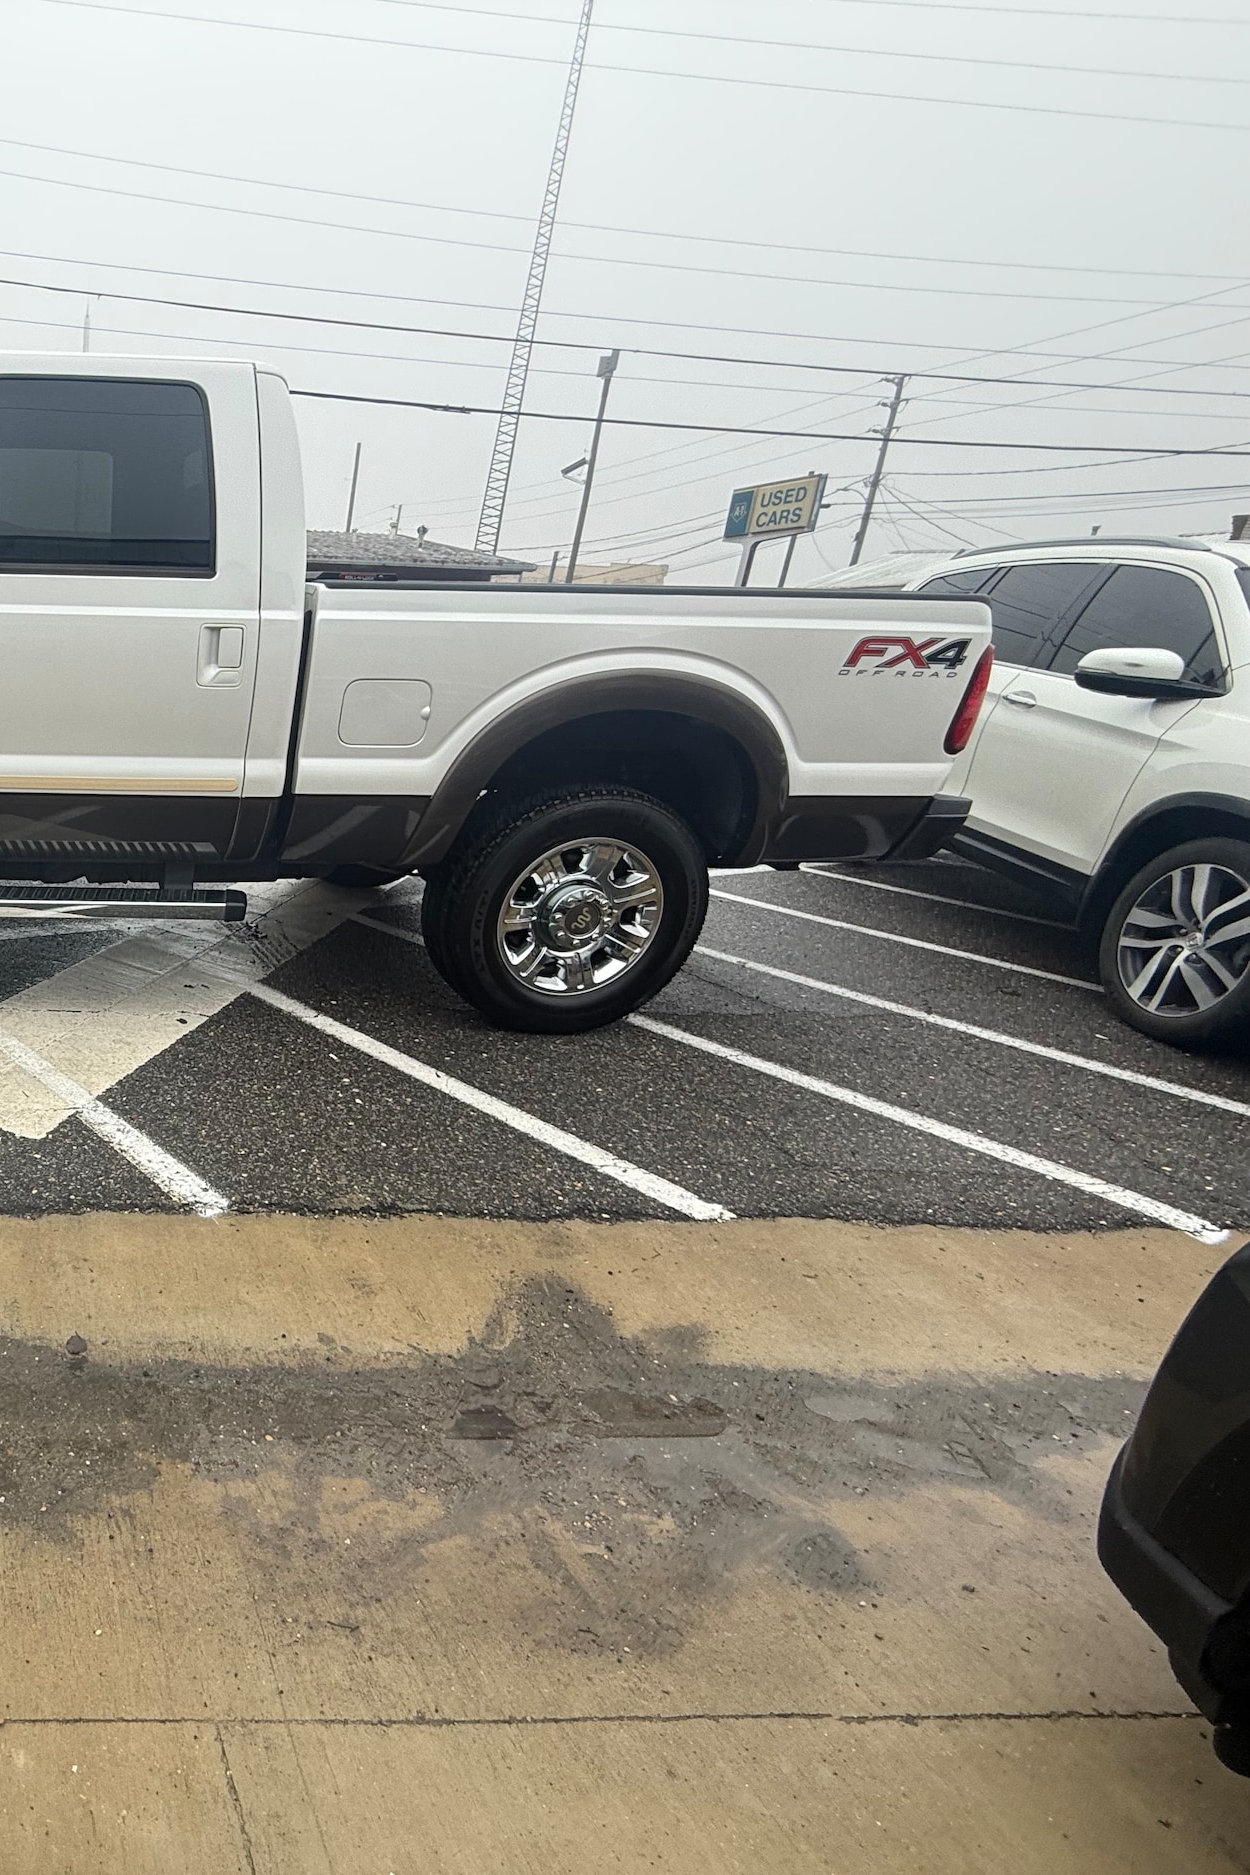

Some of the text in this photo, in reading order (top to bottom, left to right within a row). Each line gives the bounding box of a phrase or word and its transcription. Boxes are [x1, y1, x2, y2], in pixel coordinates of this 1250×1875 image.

[761, 487, 807, 508] USED
[756, 508, 802, 527] CARS
[842, 636, 973, 669] FX4
[894, 670, 958, 678] ROAD
